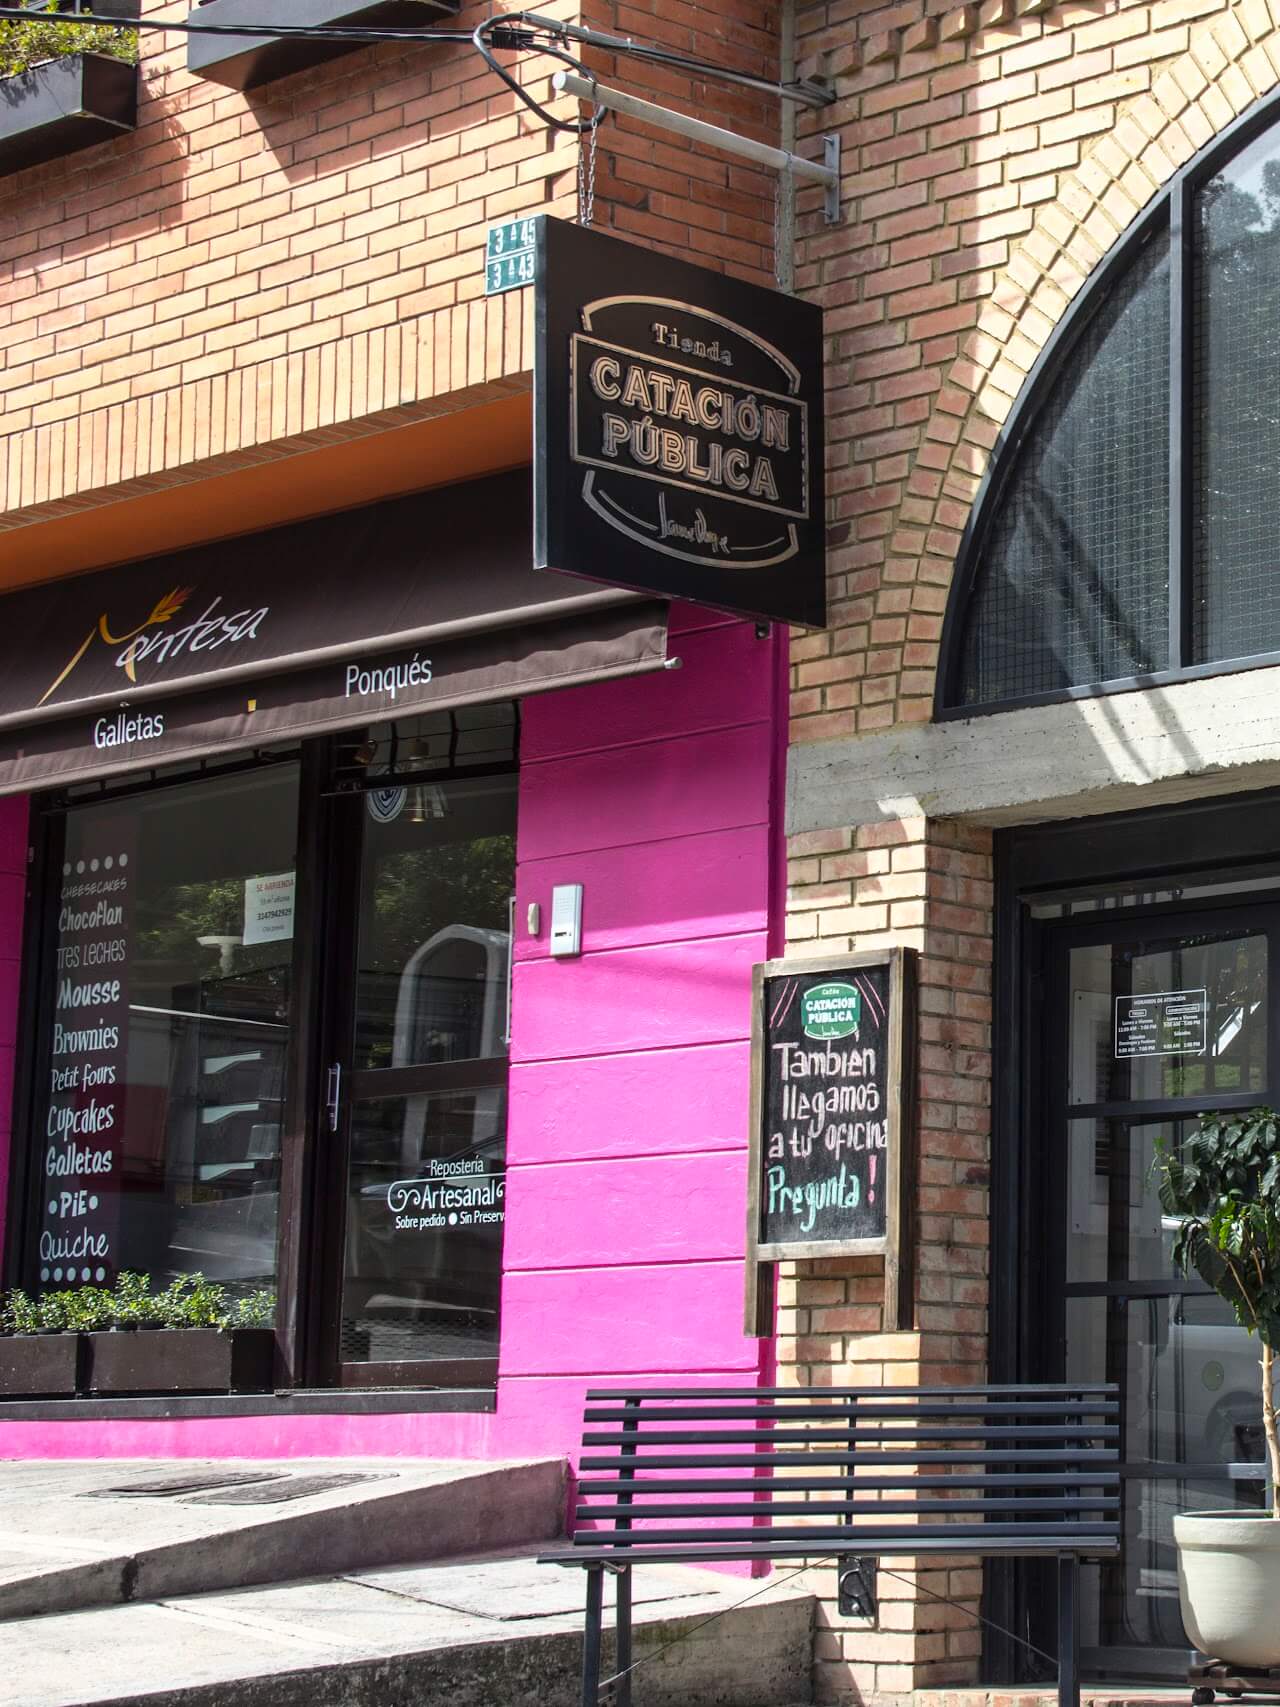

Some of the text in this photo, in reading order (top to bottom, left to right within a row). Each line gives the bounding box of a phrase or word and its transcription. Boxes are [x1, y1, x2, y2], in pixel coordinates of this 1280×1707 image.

[495, 228, 504, 254] 3
[520, 218, 536, 246] 45
[493, 263, 502, 289] 3
[518, 253, 535, 281] 43
[651, 322, 734, 367] Tienda
[588, 355, 791, 454] CATACIÓN
[601, 411, 780, 501] PÚBLICA
[345, 652, 433, 700] Ponqués
[94, 713, 165, 749] Galletas
[60, 877, 128, 900] CHEESECAKES
[58, 899, 123, 932] Chocoflan
[56, 978, 121, 1010] Mousse
[52, 1017, 119, 1055] Brownies
[51, 1063, 117, 1093] Petit fours
[47, 1098, 115, 1142] Cupcakes
[782, 1082, 880, 1138] llegamos
[768, 1118, 889, 1161] a tu oficina
[46, 1142, 113, 1177] Galletas
[430, 1155, 484, 1178] Repostería
[420, 1178, 496, 1210] Artesanal
[395, 1210, 506, 1231] Sobre pedido Sin Preserv
[39, 1226, 110, 1262] Quiche
